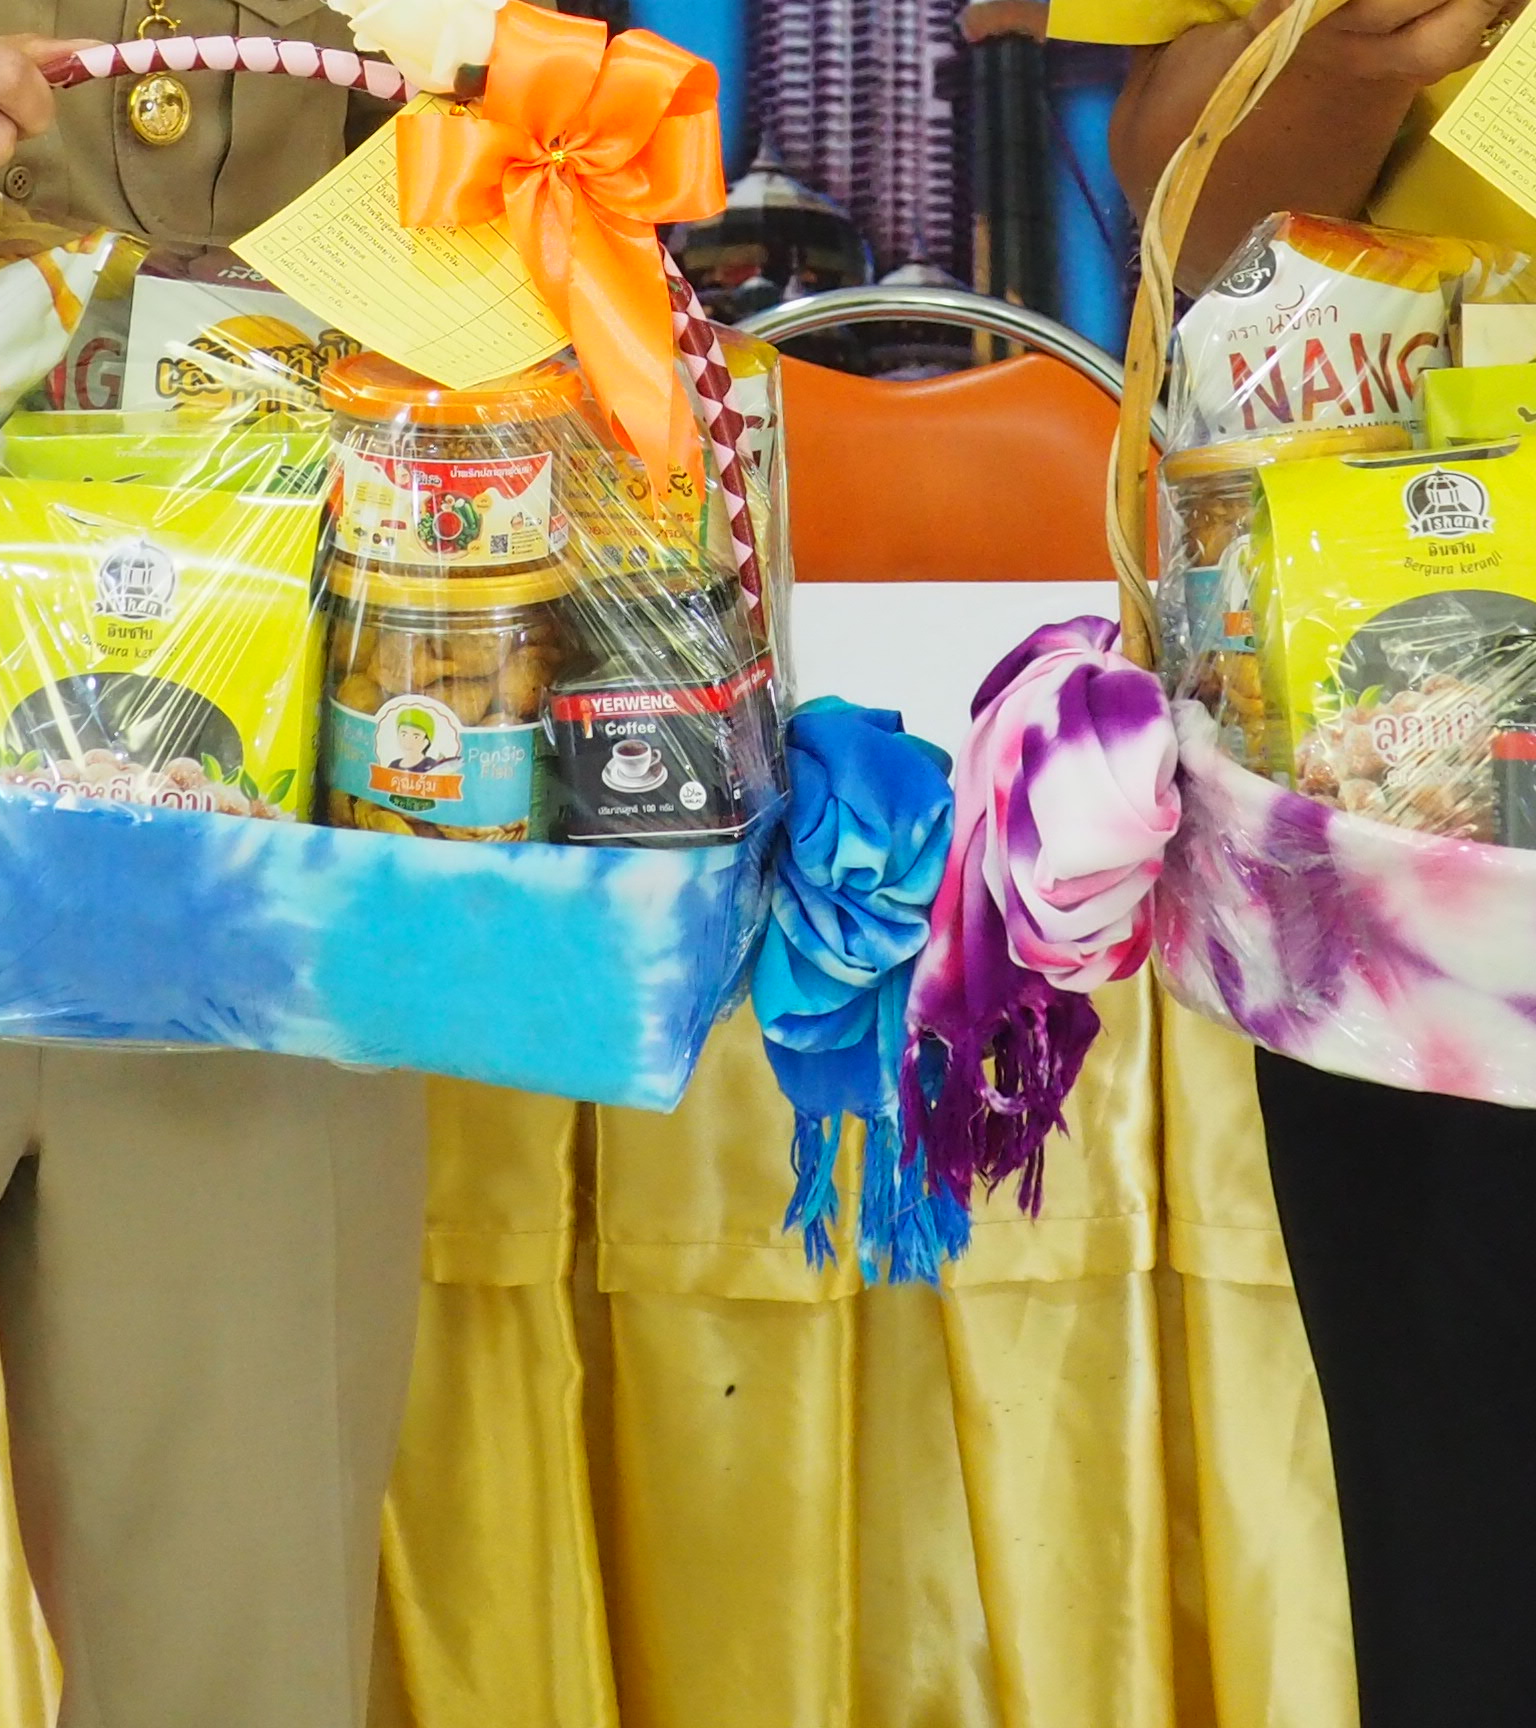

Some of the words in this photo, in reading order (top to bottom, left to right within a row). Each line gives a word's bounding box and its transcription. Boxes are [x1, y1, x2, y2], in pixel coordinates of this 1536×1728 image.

[1428, 515, 1475, 532] Ishan
[107, 597, 160, 616] han
[605, 722, 656, 736] Coffee
[642, 804, 656, 813] 100
